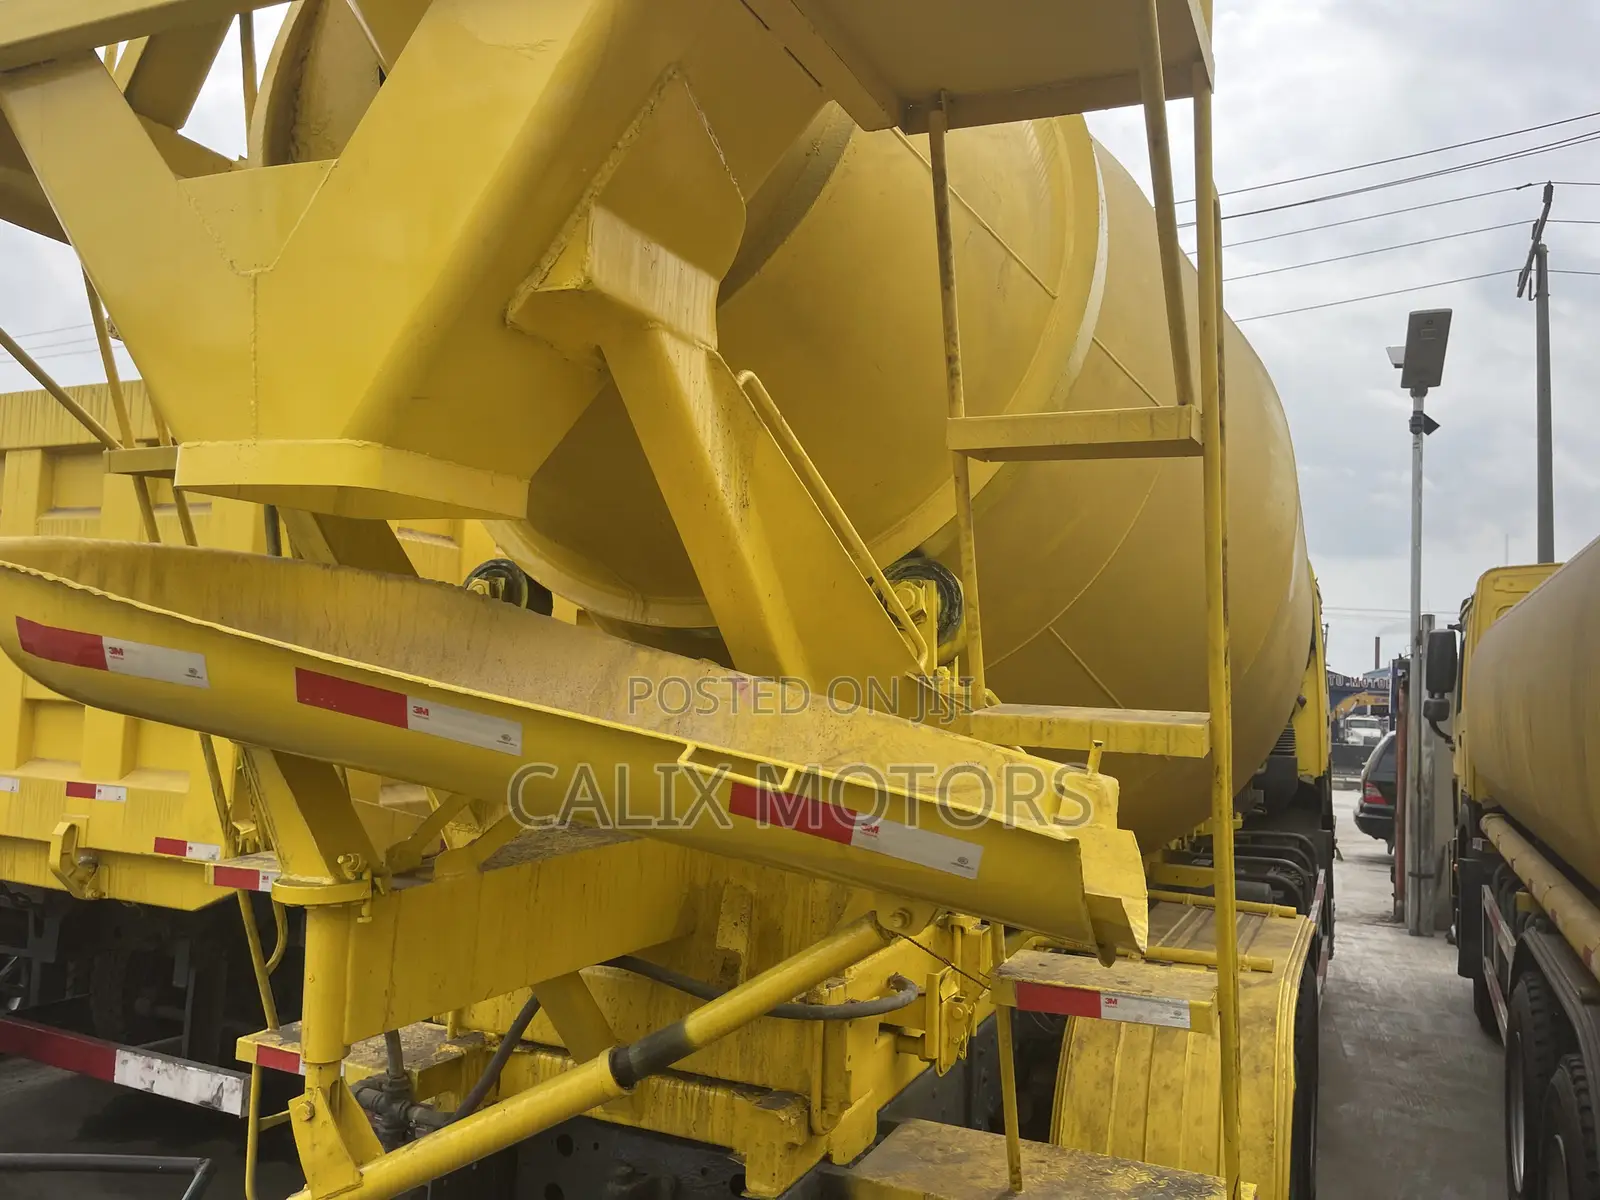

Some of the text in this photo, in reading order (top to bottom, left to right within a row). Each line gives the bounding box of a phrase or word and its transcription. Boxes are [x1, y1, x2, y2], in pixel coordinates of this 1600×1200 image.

[108, 646, 124, 656] 3M
[412, 705, 429, 717] 3M
[861, 822, 879, 834] 3M
[1104, 997, 1118, 1005] 3M
